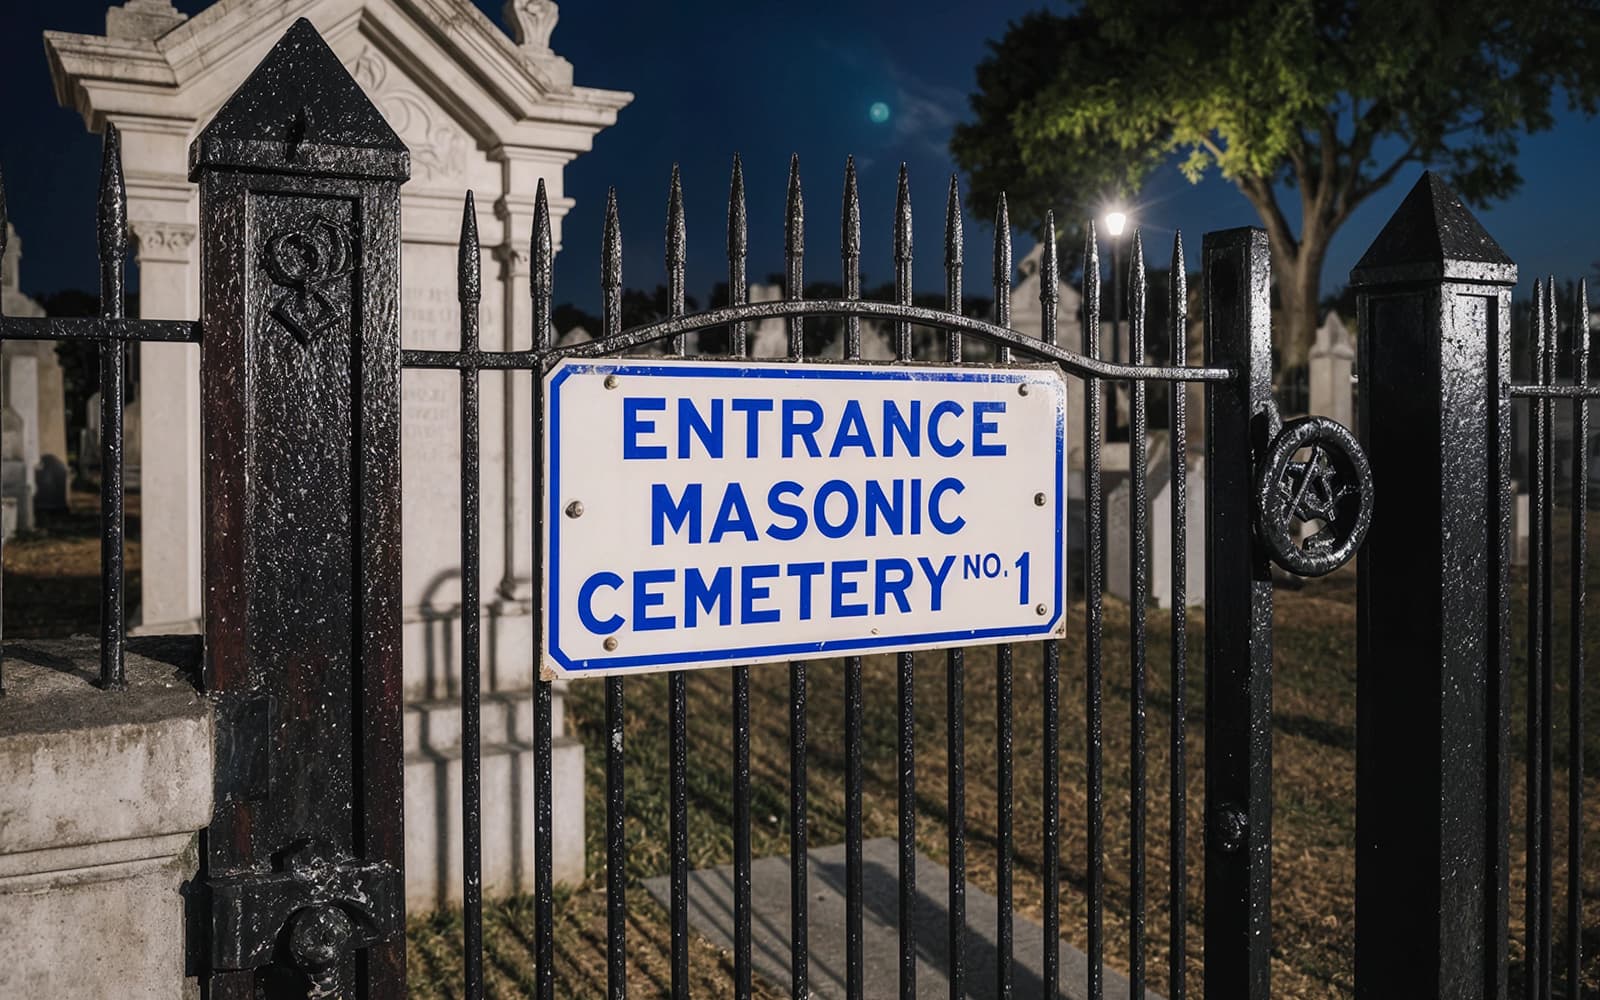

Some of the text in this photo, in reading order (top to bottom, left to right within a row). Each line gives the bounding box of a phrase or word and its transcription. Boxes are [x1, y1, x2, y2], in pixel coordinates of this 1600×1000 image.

[622, 396, 1008, 461] ENTRANCE
[651, 476, 967, 547] MASONIC
[577, 550, 1032, 636] CEMETERY NO. 1
